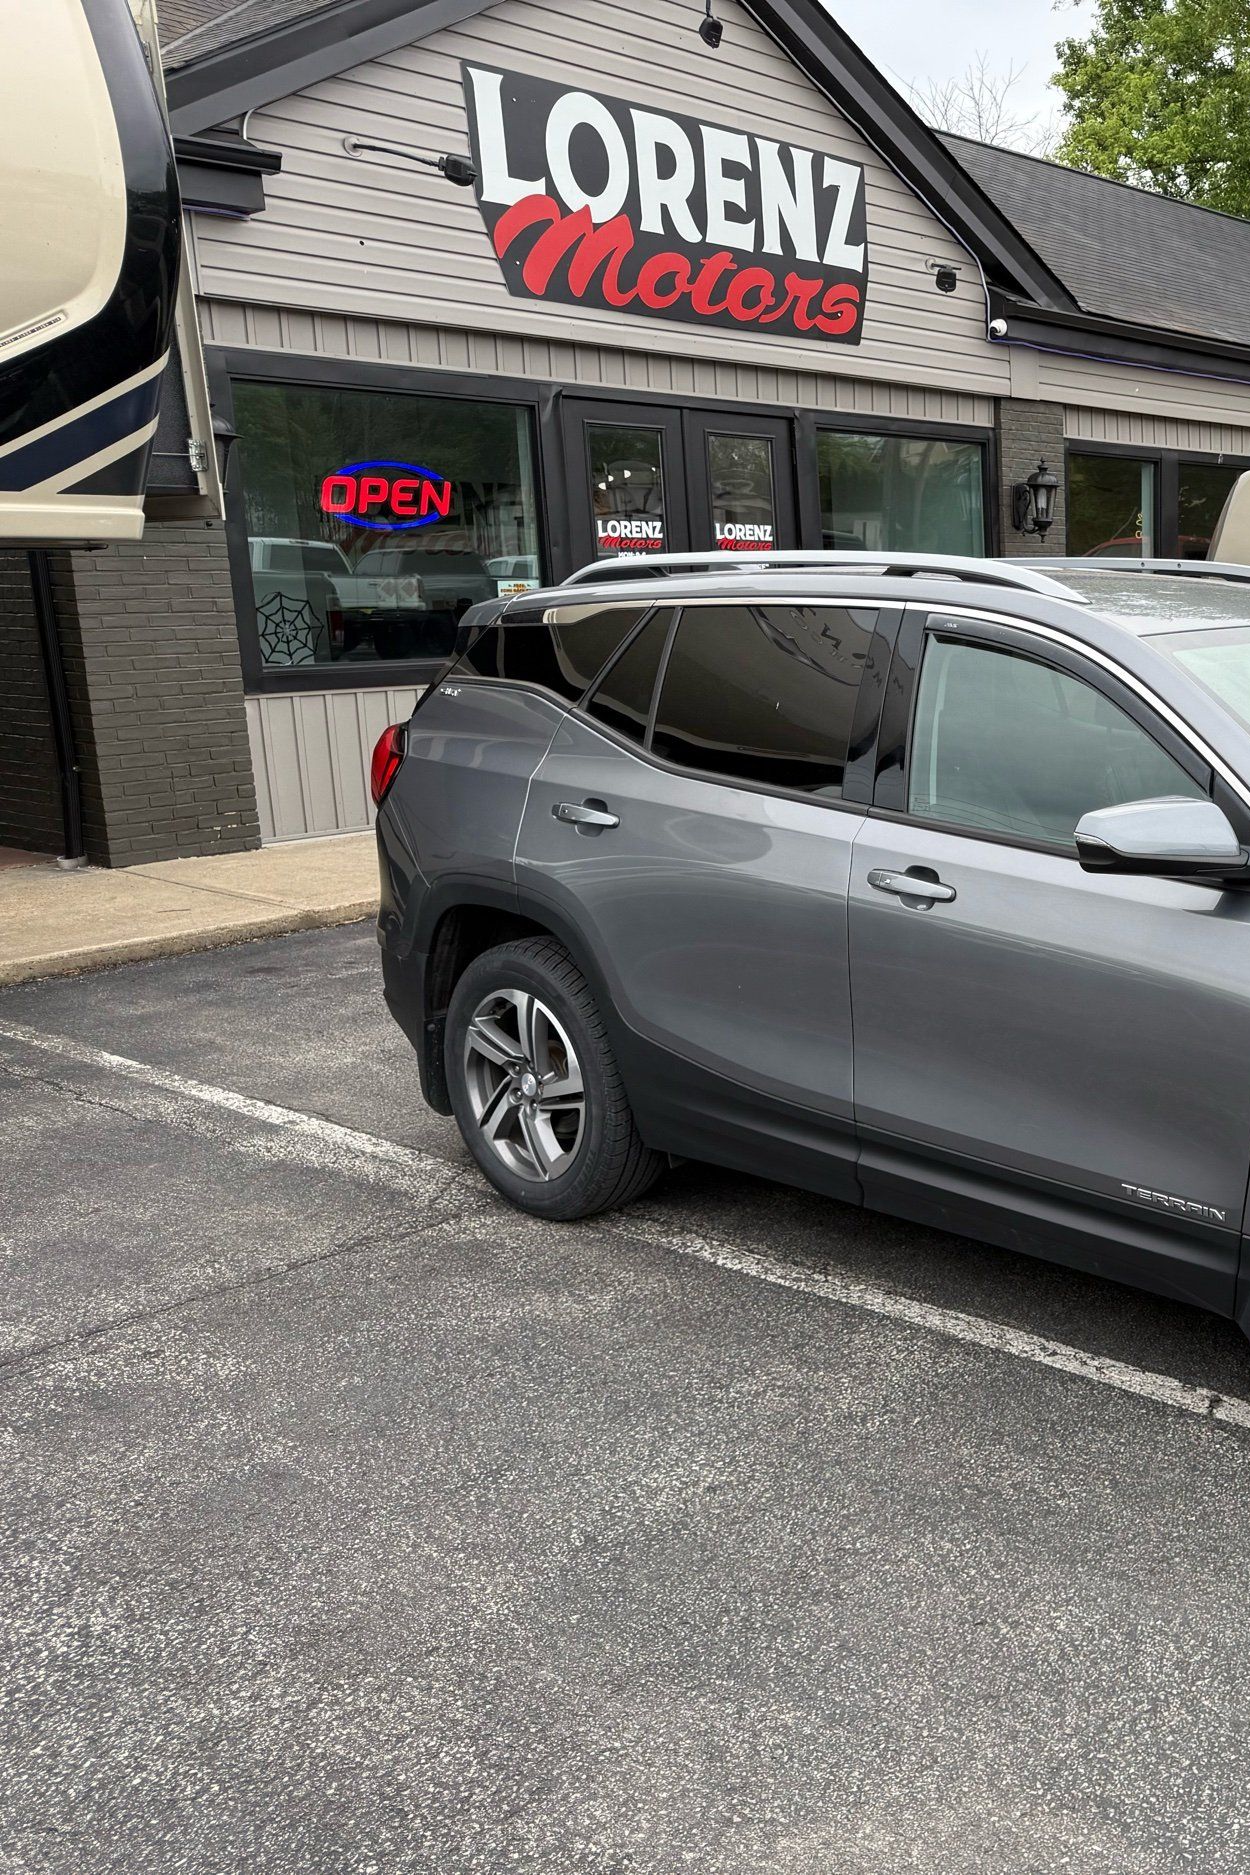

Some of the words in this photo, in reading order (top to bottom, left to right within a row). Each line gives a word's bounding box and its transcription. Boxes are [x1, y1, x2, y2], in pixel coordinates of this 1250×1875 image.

[466, 66, 865, 273] LORENZ
[493, 193, 860, 335] Motors
[320, 476, 452, 517] OPEN
[597, 520, 663, 538] LORENZ
[599, 536, 662, 549] Motors
[715, 523, 773, 541] LORENZ
[716, 538, 772, 551] Motors
[1121, 1183, 1226, 1222] TERRAIN
